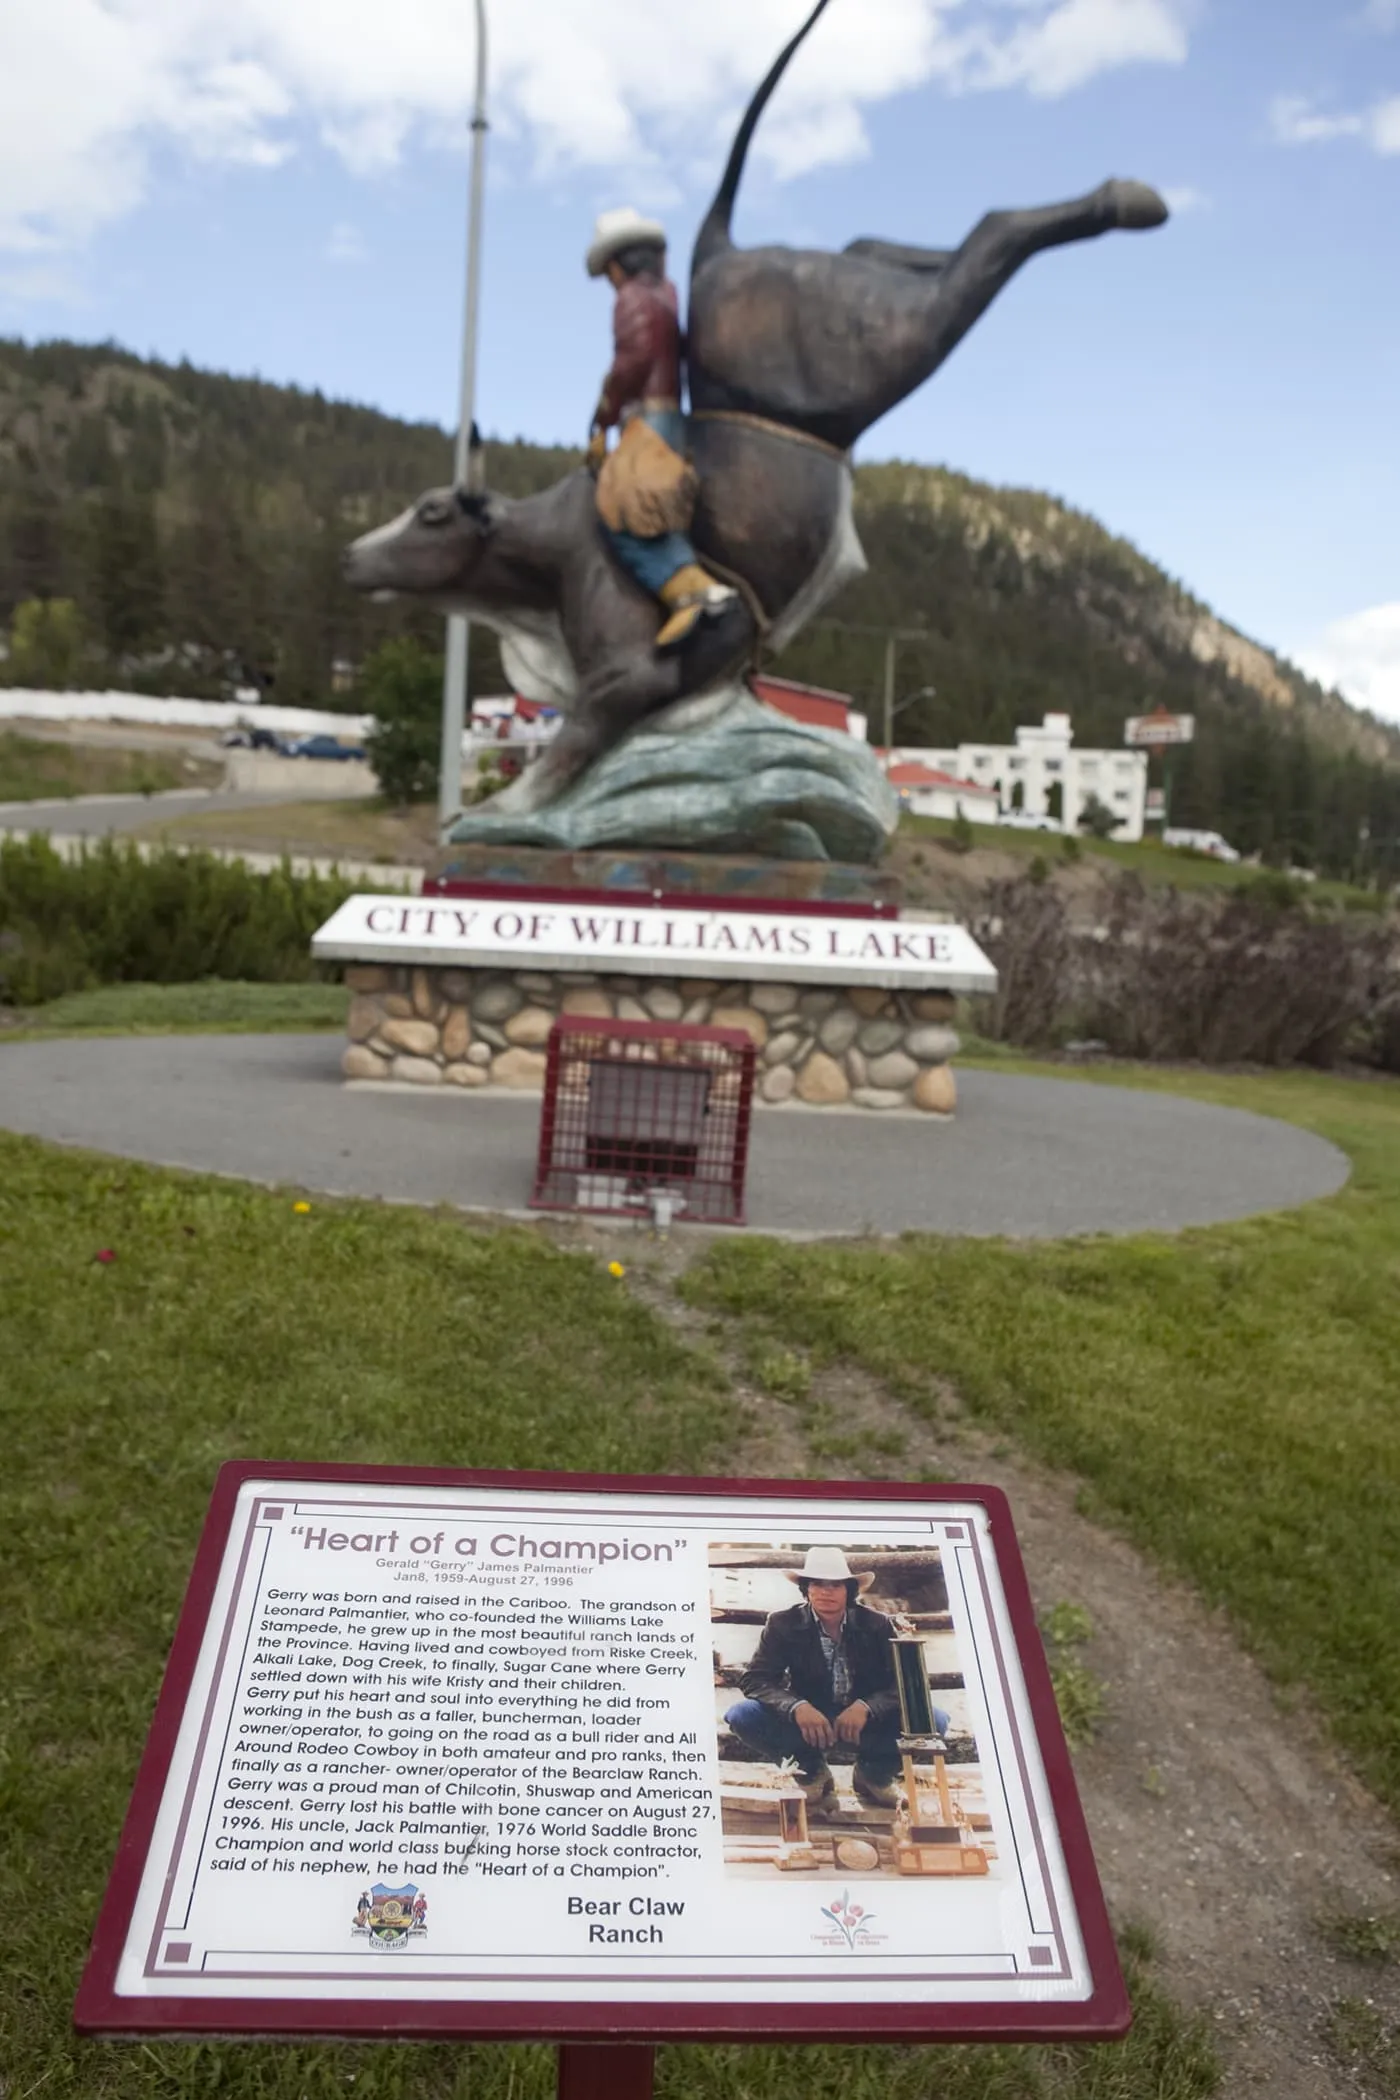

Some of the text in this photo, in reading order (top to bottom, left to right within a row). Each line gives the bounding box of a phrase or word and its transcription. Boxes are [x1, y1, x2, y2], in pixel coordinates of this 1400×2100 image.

[366, 905, 952, 962] CITY OF WILLIAMS LAKE
[410, 1532, 445, 1555] of
[455, 1538, 478, 1557] a
[376, 1558, 420, 1569] Gerald
[478, 1562, 520, 1573] James
[524, 1563, 594, 1575] Palmantier
[394, 1572, 429, 1583] Jan8,
[520, 1576, 539, 1587] 27,
[544, 1577, 574, 1587] 1996
[268, 1589, 677, 1613] Gerry was born and raised the Cariboo. The grandson
[264, 1604, 665, 1628] Leonard Palmantier, who co-founded the Williams Lake
[260, 1620, 677, 1644] Stampede, grew the most beautiful ranch lands
[258, 1636, 698, 1661] the Province. Having lived and cowboyed from Riske Creek,
[252, 1653, 687, 1679] Alkali Lake, Dog Creek, finally, Sugar Cane where Gerry
[250, 1670, 627, 1692] settled down with his wife Kristy and their children.
[247, 1686, 671, 1711] Gerry put his heart and soul into everything he did from
[244, 1704, 643, 1727] working the bush faller, buncherman, loader
[239, 1723, 697, 1745] owner/operator, going the road bull rider and All
[234, 1740, 707, 1765] Around Rodeo Cowboy both amateur and pro ranks, then
[232, 1758, 703, 1781] finally rancher- owner/operator the Bearclaw Ranch.
[228, 1777, 713, 1801] Gerry was proud man Chilcotin, Shuswap and American
[224, 1796, 717, 1822] descent. Gerry lost his battle with bone cancer August 27,
[222, 1816, 699, 1839] 1996. His uncle, Jack 1976 World Saddle Bronc
[215, 1836, 702, 1860] Champion and world class horse stock contractor,
[210, 1857, 247, 1872] said
[272, 1858, 296, 1873] his
[300, 1860, 371, 1877] nephew,
[377, 1860, 399, 1875] he
[404, 1860, 438, 1875] had
[568, 1896, 686, 1917] Bear Claw
[589, 1924, 664, 1944] Ranch
